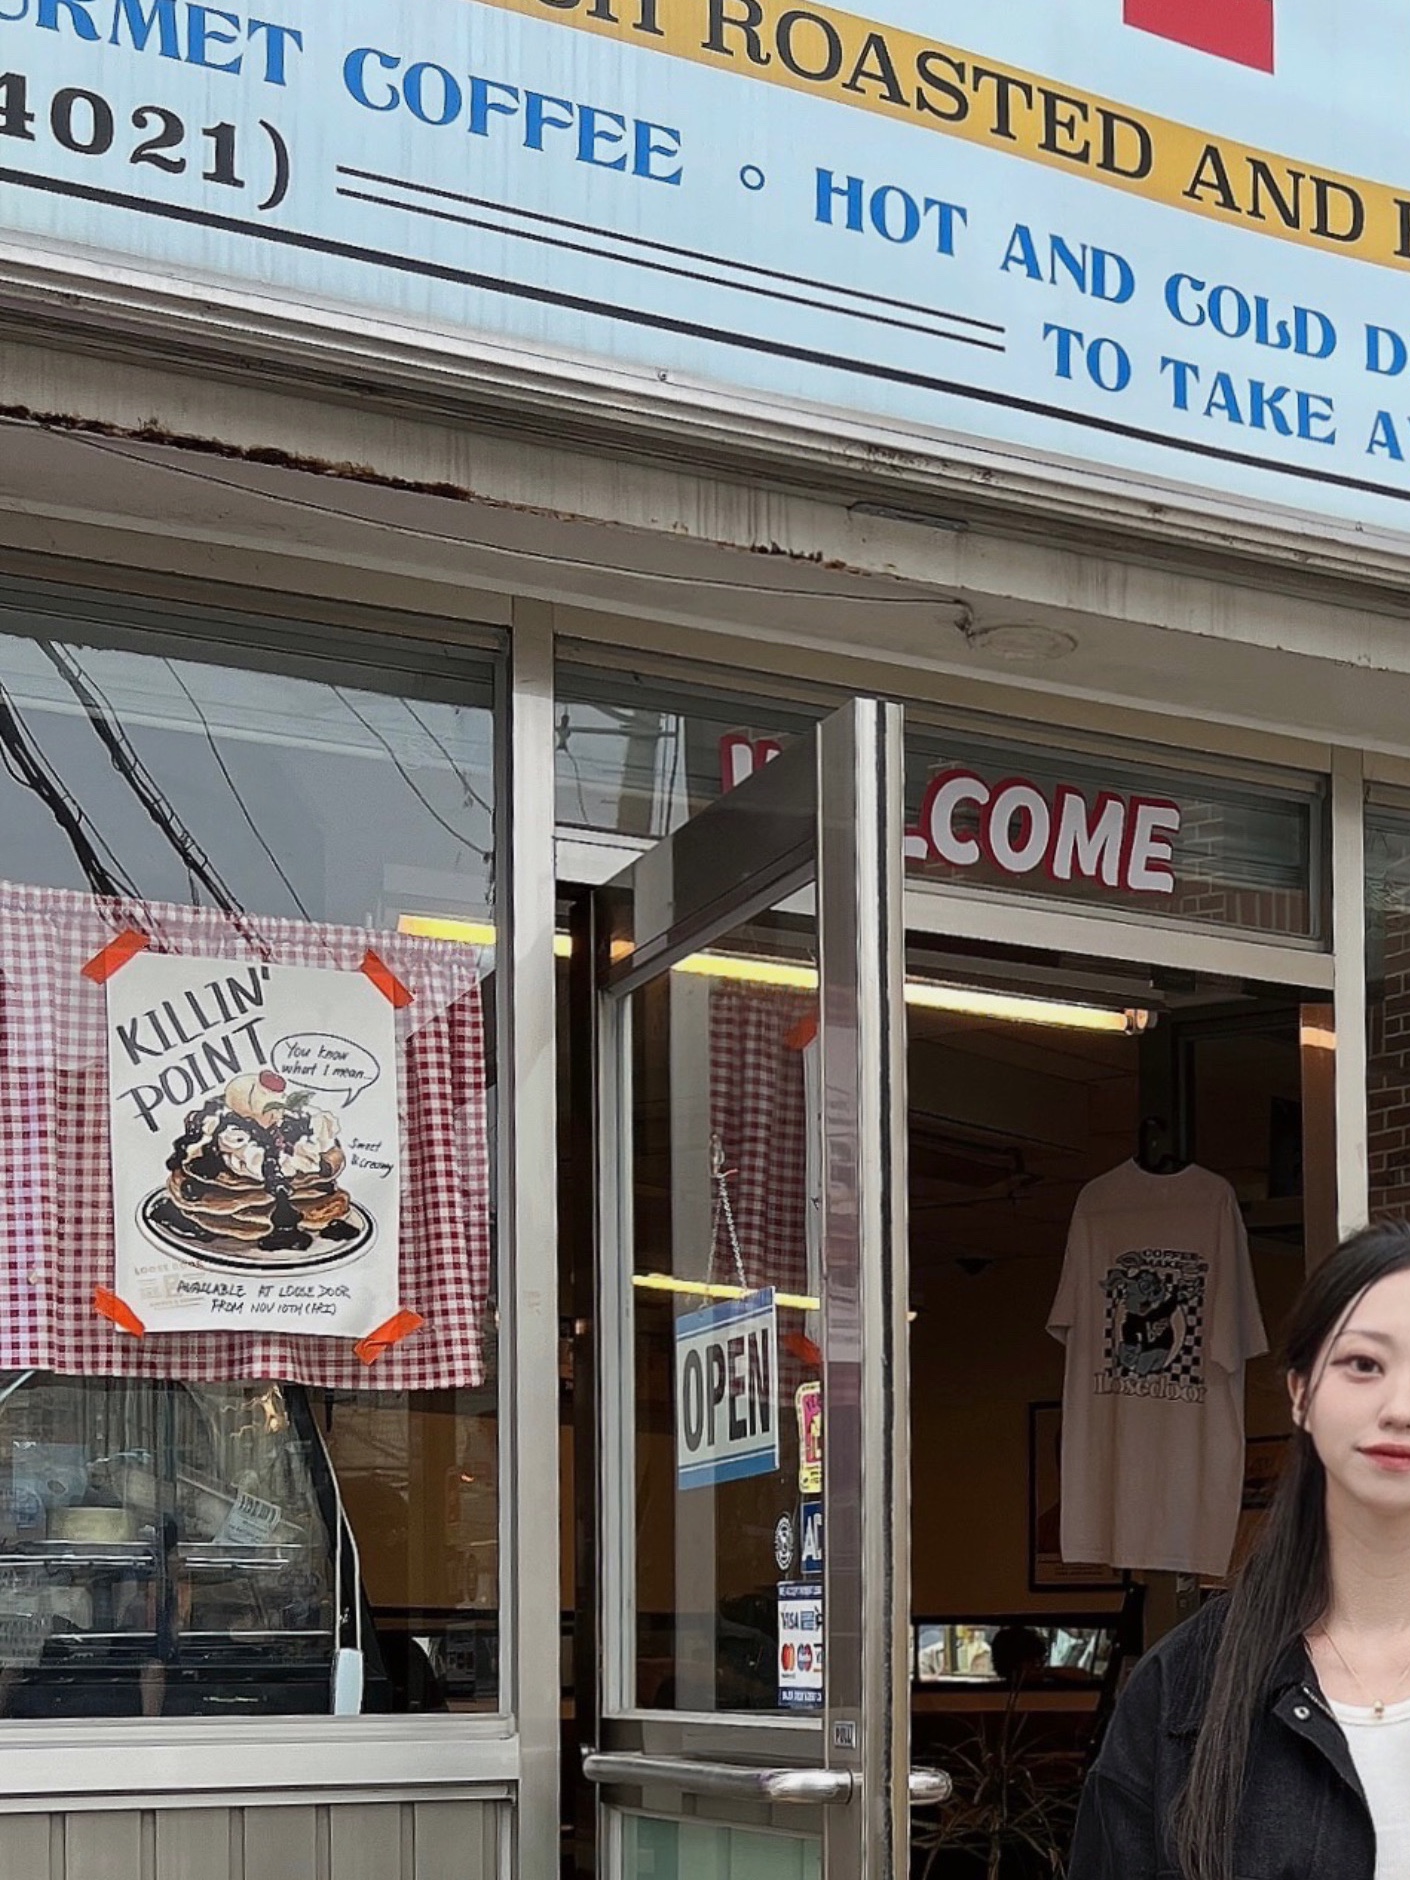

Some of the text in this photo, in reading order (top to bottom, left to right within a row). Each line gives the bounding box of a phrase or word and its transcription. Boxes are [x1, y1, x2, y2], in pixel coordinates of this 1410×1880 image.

[701, 0, 1154, 181] ROASTED
[1183, 144, 1365, 244] AND
[342, 47, 684, 186] COFFEE
[815, 167, 968, 257] HOT
[1000, 223, 1135, 305] AND
[1164, 272, 1338, 360] COLD
[1042, 322, 1132, 394] TO
[1160, 355, 1337, 447] TAKE
[116, 966, 271, 1067] KILLIN'
[281, 1060, 318, 1076] what
[322, 1064, 331, 1077] I
[285, 1040, 349, 1061] You know
[116, 1017, 268, 1133] POINT
[210, 1300, 244, 1314] FROM
[250, 1301, 275, 1314] NOV
[258, 1285, 274, 1298] AT
[317, 1284, 352, 1299] DOOR
[682, 1327, 771, 1453] OPEN
